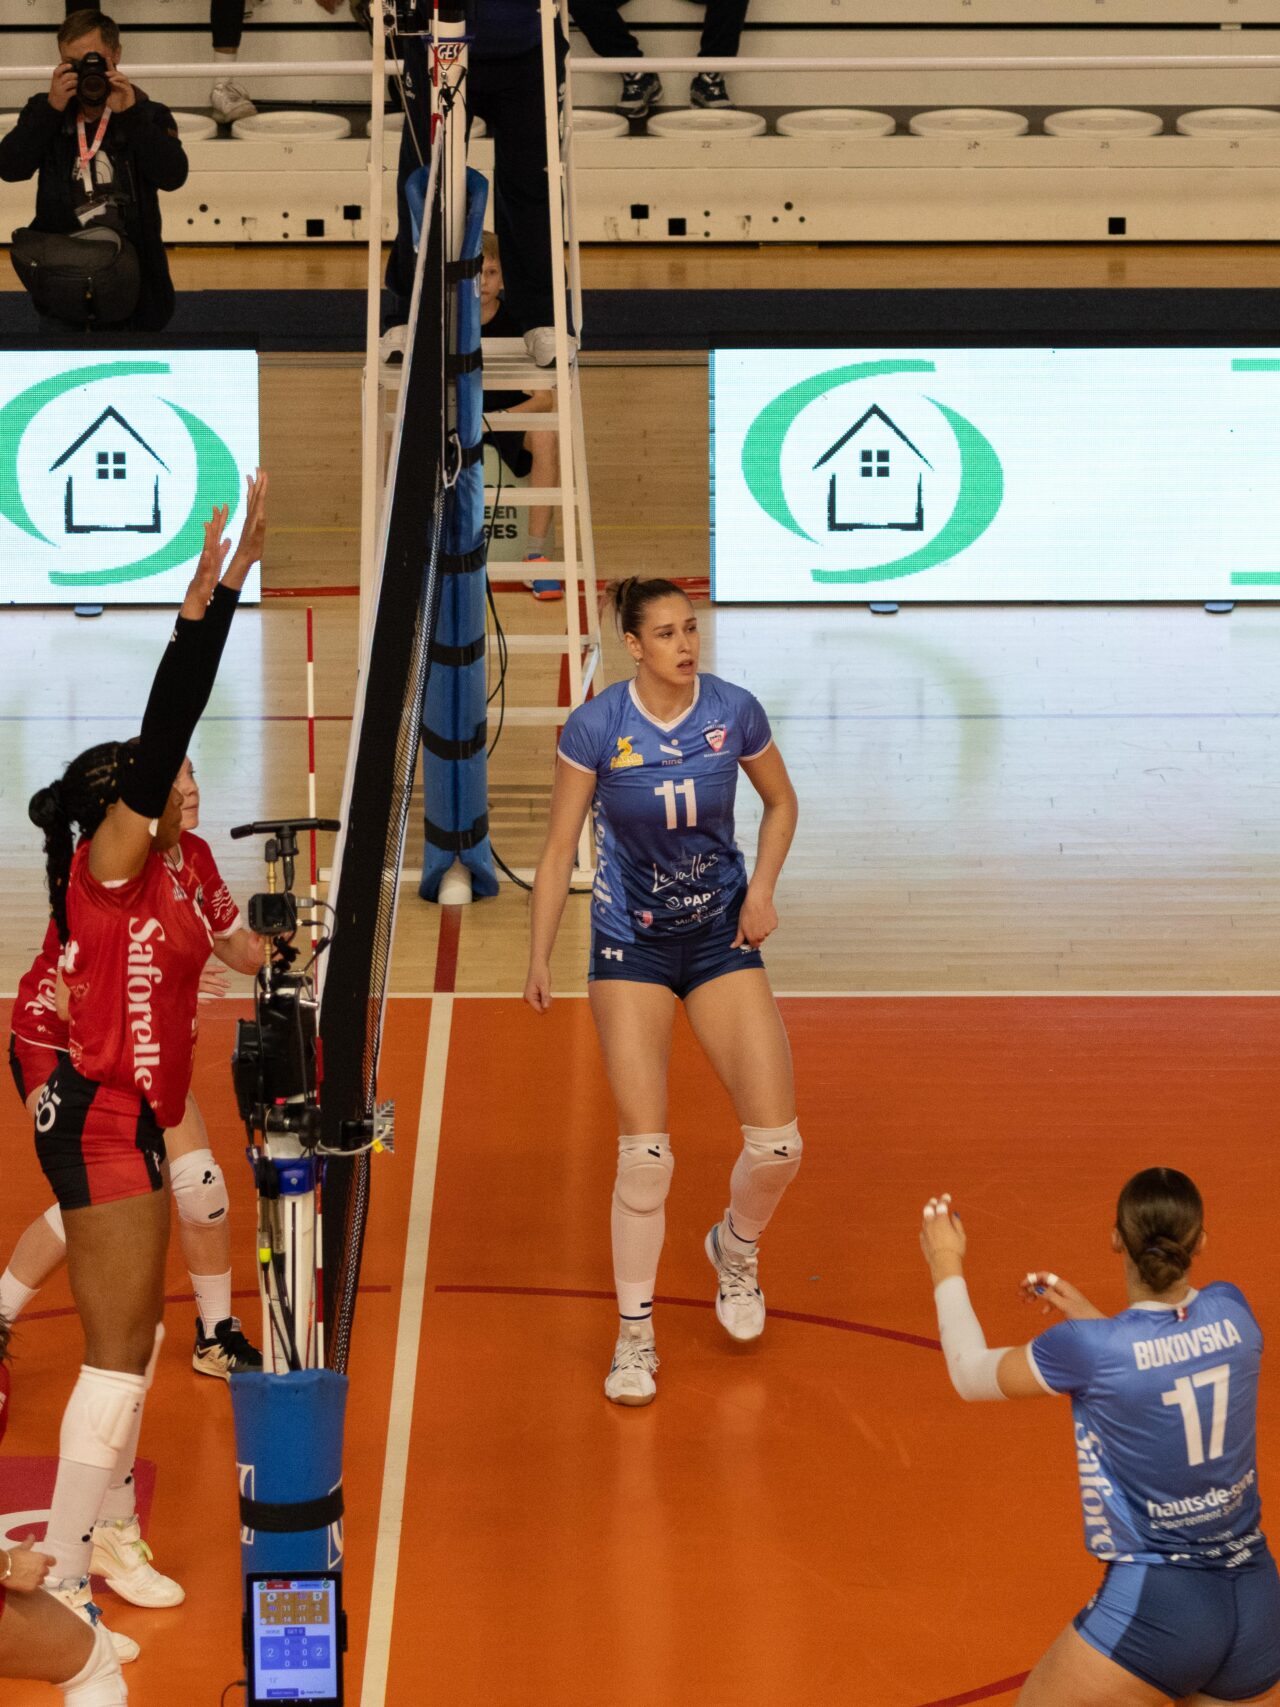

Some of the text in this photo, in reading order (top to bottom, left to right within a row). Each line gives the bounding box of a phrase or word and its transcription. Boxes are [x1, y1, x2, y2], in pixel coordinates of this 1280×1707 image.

[662, 758, 683, 766] nine
[654, 778, 697, 830] 11
[127, 917, 166, 1090] Saforelle
[1132, 1318, 1242, 1371] BUKOVSKA
[1161, 1363, 1230, 1467] 17
[267, 1648, 275, 1658] 2
[316, 1647, 322, 1657] 2
